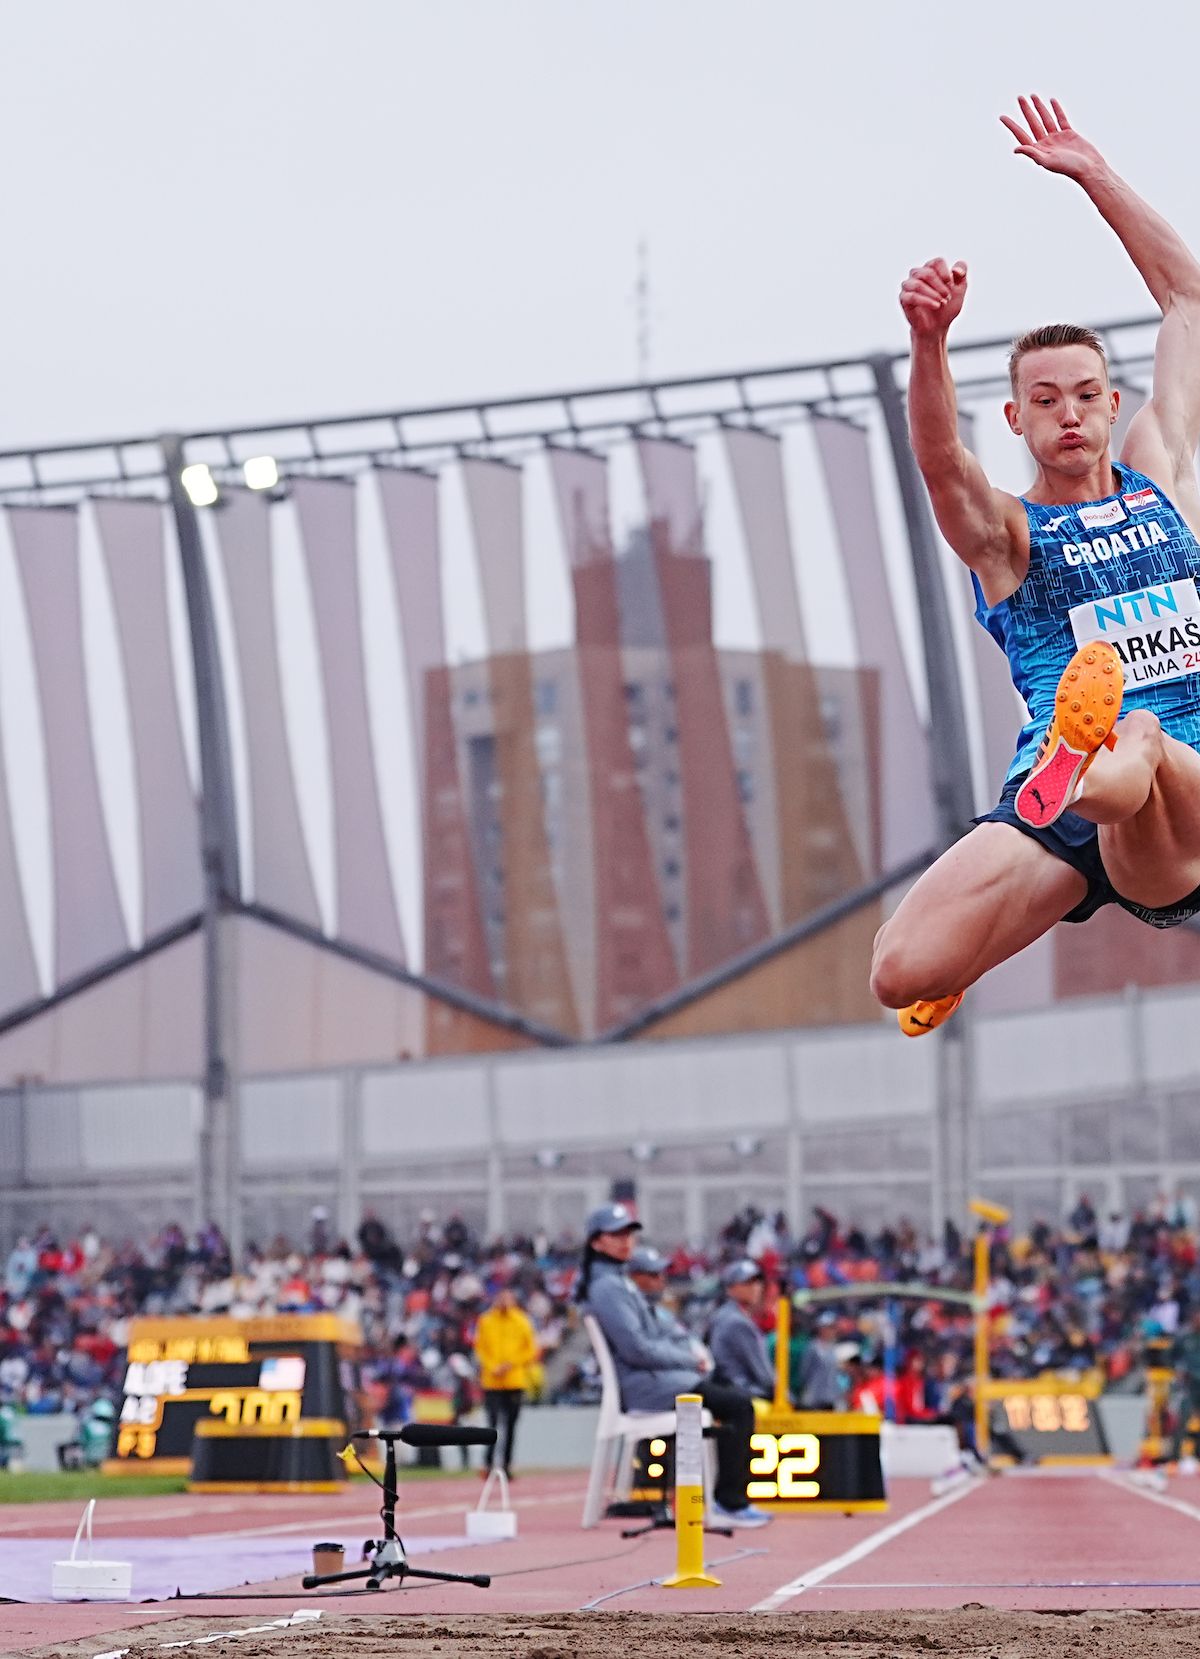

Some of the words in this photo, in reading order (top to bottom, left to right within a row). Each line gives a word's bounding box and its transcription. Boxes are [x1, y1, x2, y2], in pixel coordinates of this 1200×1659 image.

[1062, 521, 1170, 566] CROATIA
[1093, 586, 1179, 632] NTN
[1133, 658, 1180, 682] LIMA
